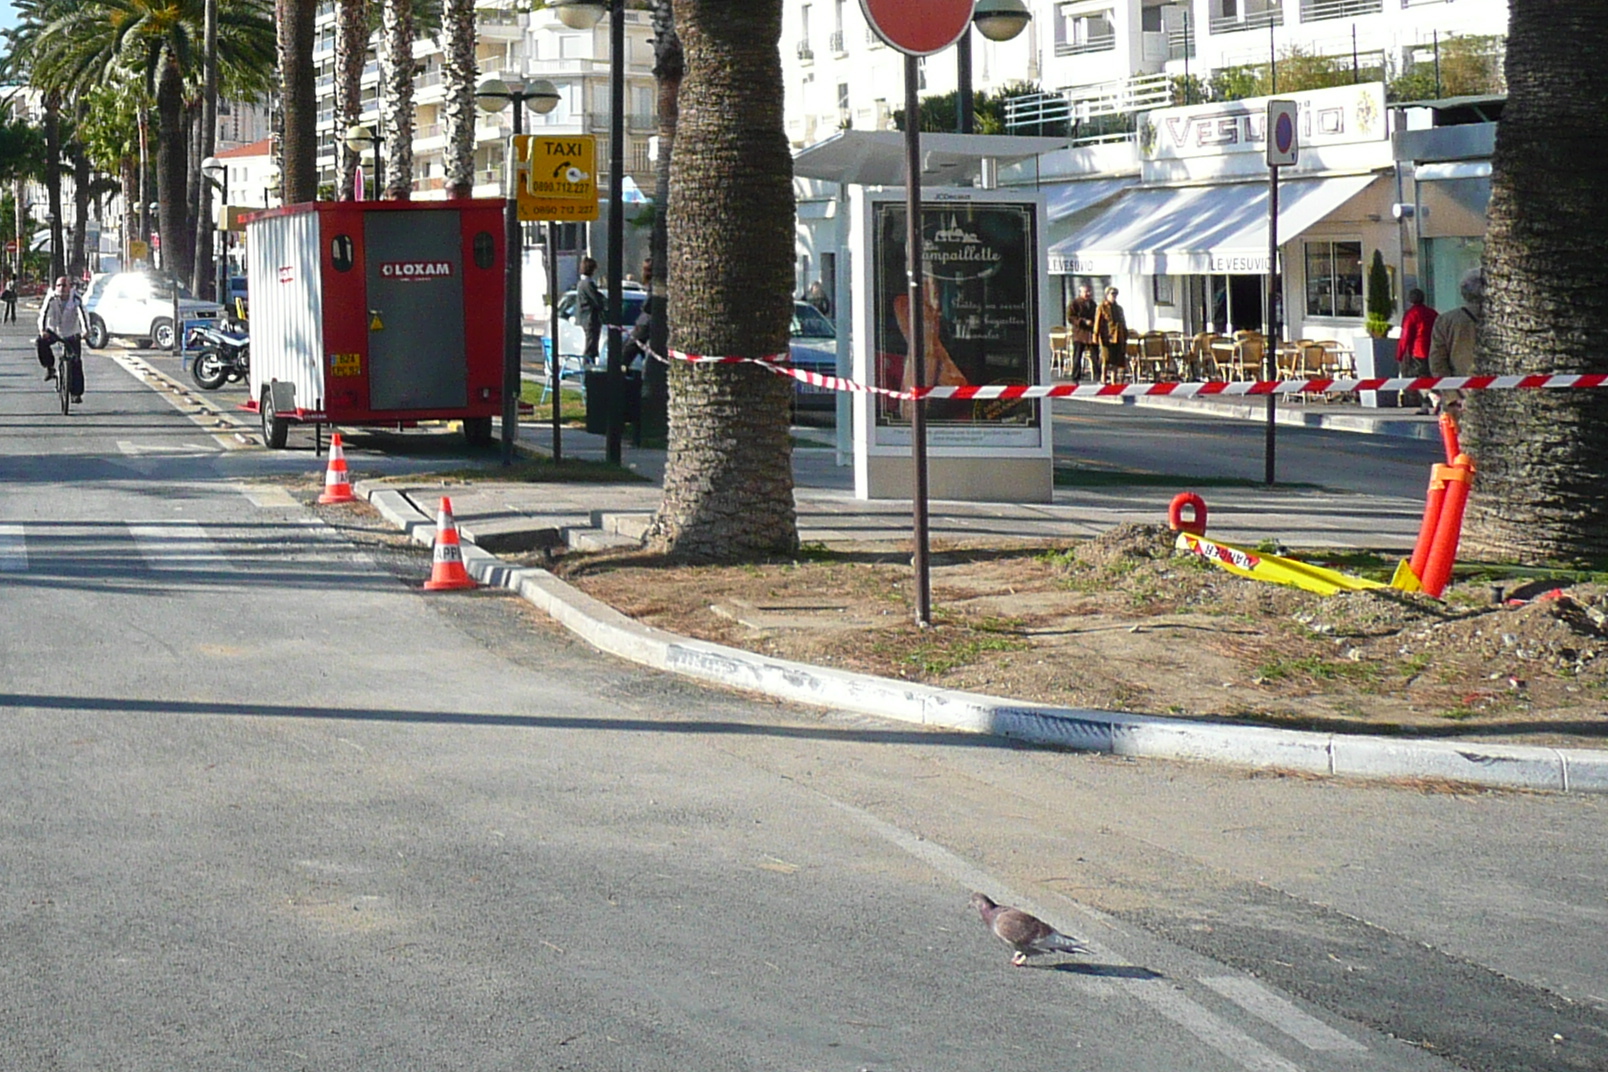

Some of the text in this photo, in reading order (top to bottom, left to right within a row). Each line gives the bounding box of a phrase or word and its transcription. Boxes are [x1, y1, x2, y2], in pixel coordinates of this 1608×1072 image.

[544, 142, 582, 156] TAXI
[922, 245, 1000, 264] ampaillette
[394, 263, 450, 276] LOXAM
[1210, 257, 1225, 271] LE
[1205, 544, 1252, 567] DANGER
